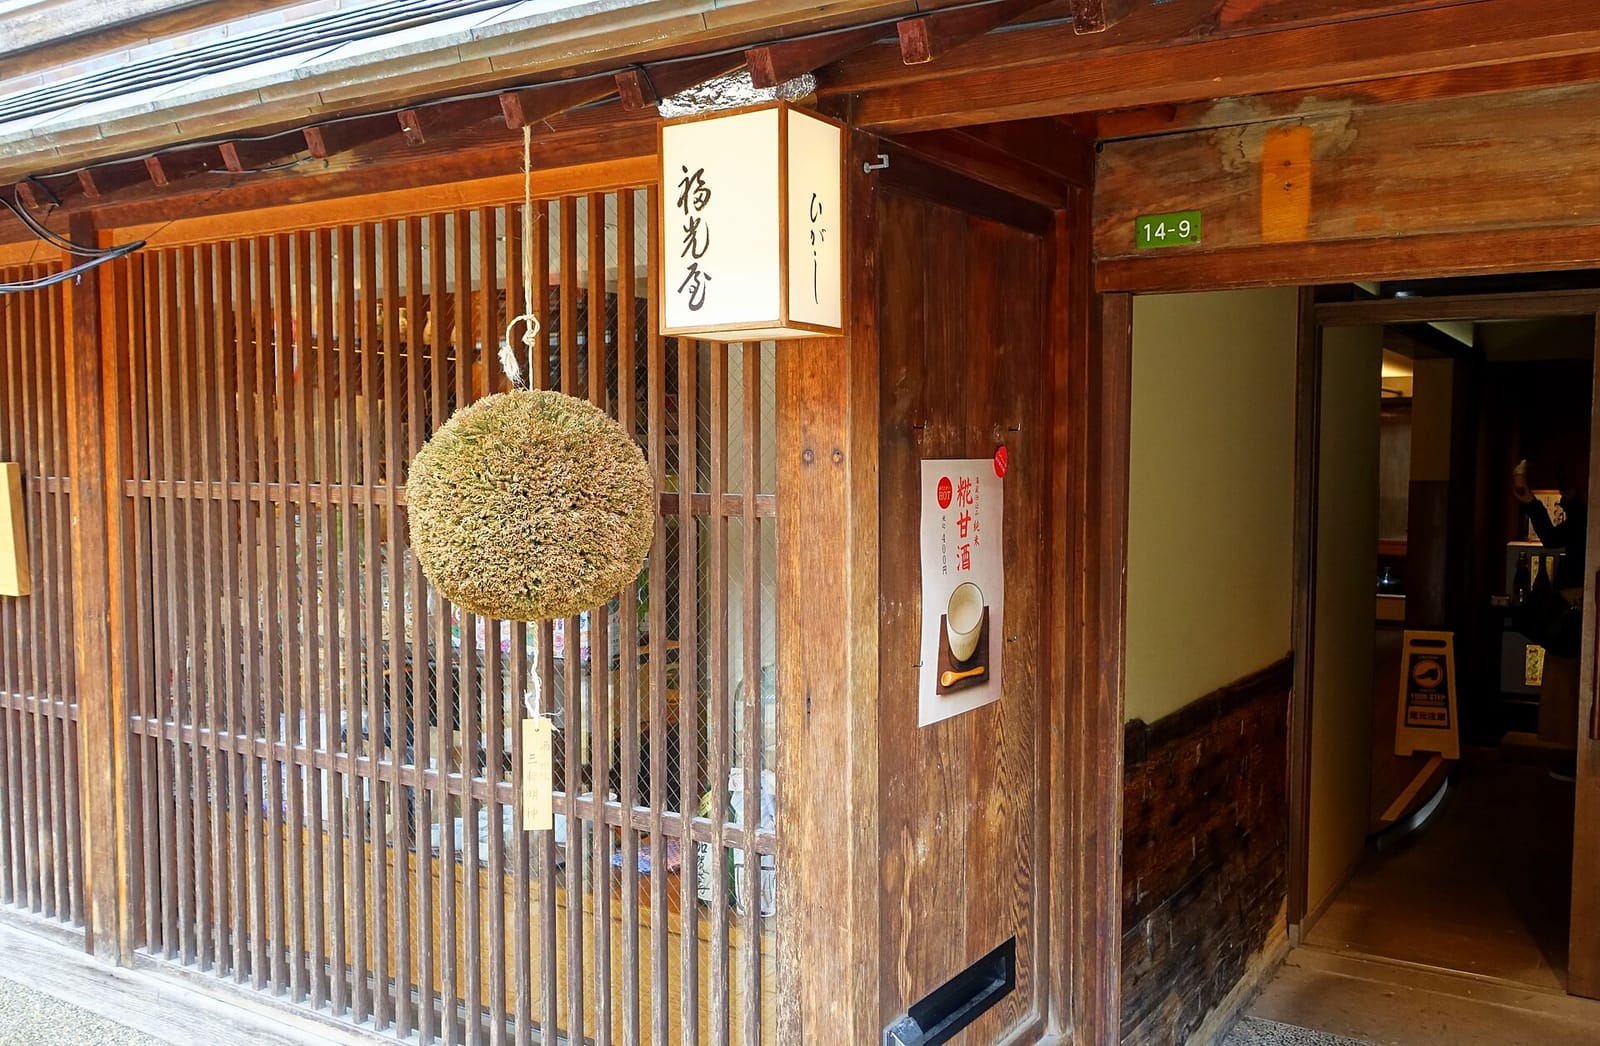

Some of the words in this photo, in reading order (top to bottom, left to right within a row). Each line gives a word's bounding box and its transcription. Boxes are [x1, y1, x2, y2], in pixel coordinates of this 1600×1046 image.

[677, 165, 712, 311] 福光屋
[810, 193, 826, 304] ひがし
[1144, 220, 1190, 241] 14-9
[957, 476, 973, 571] 糀甘酒
